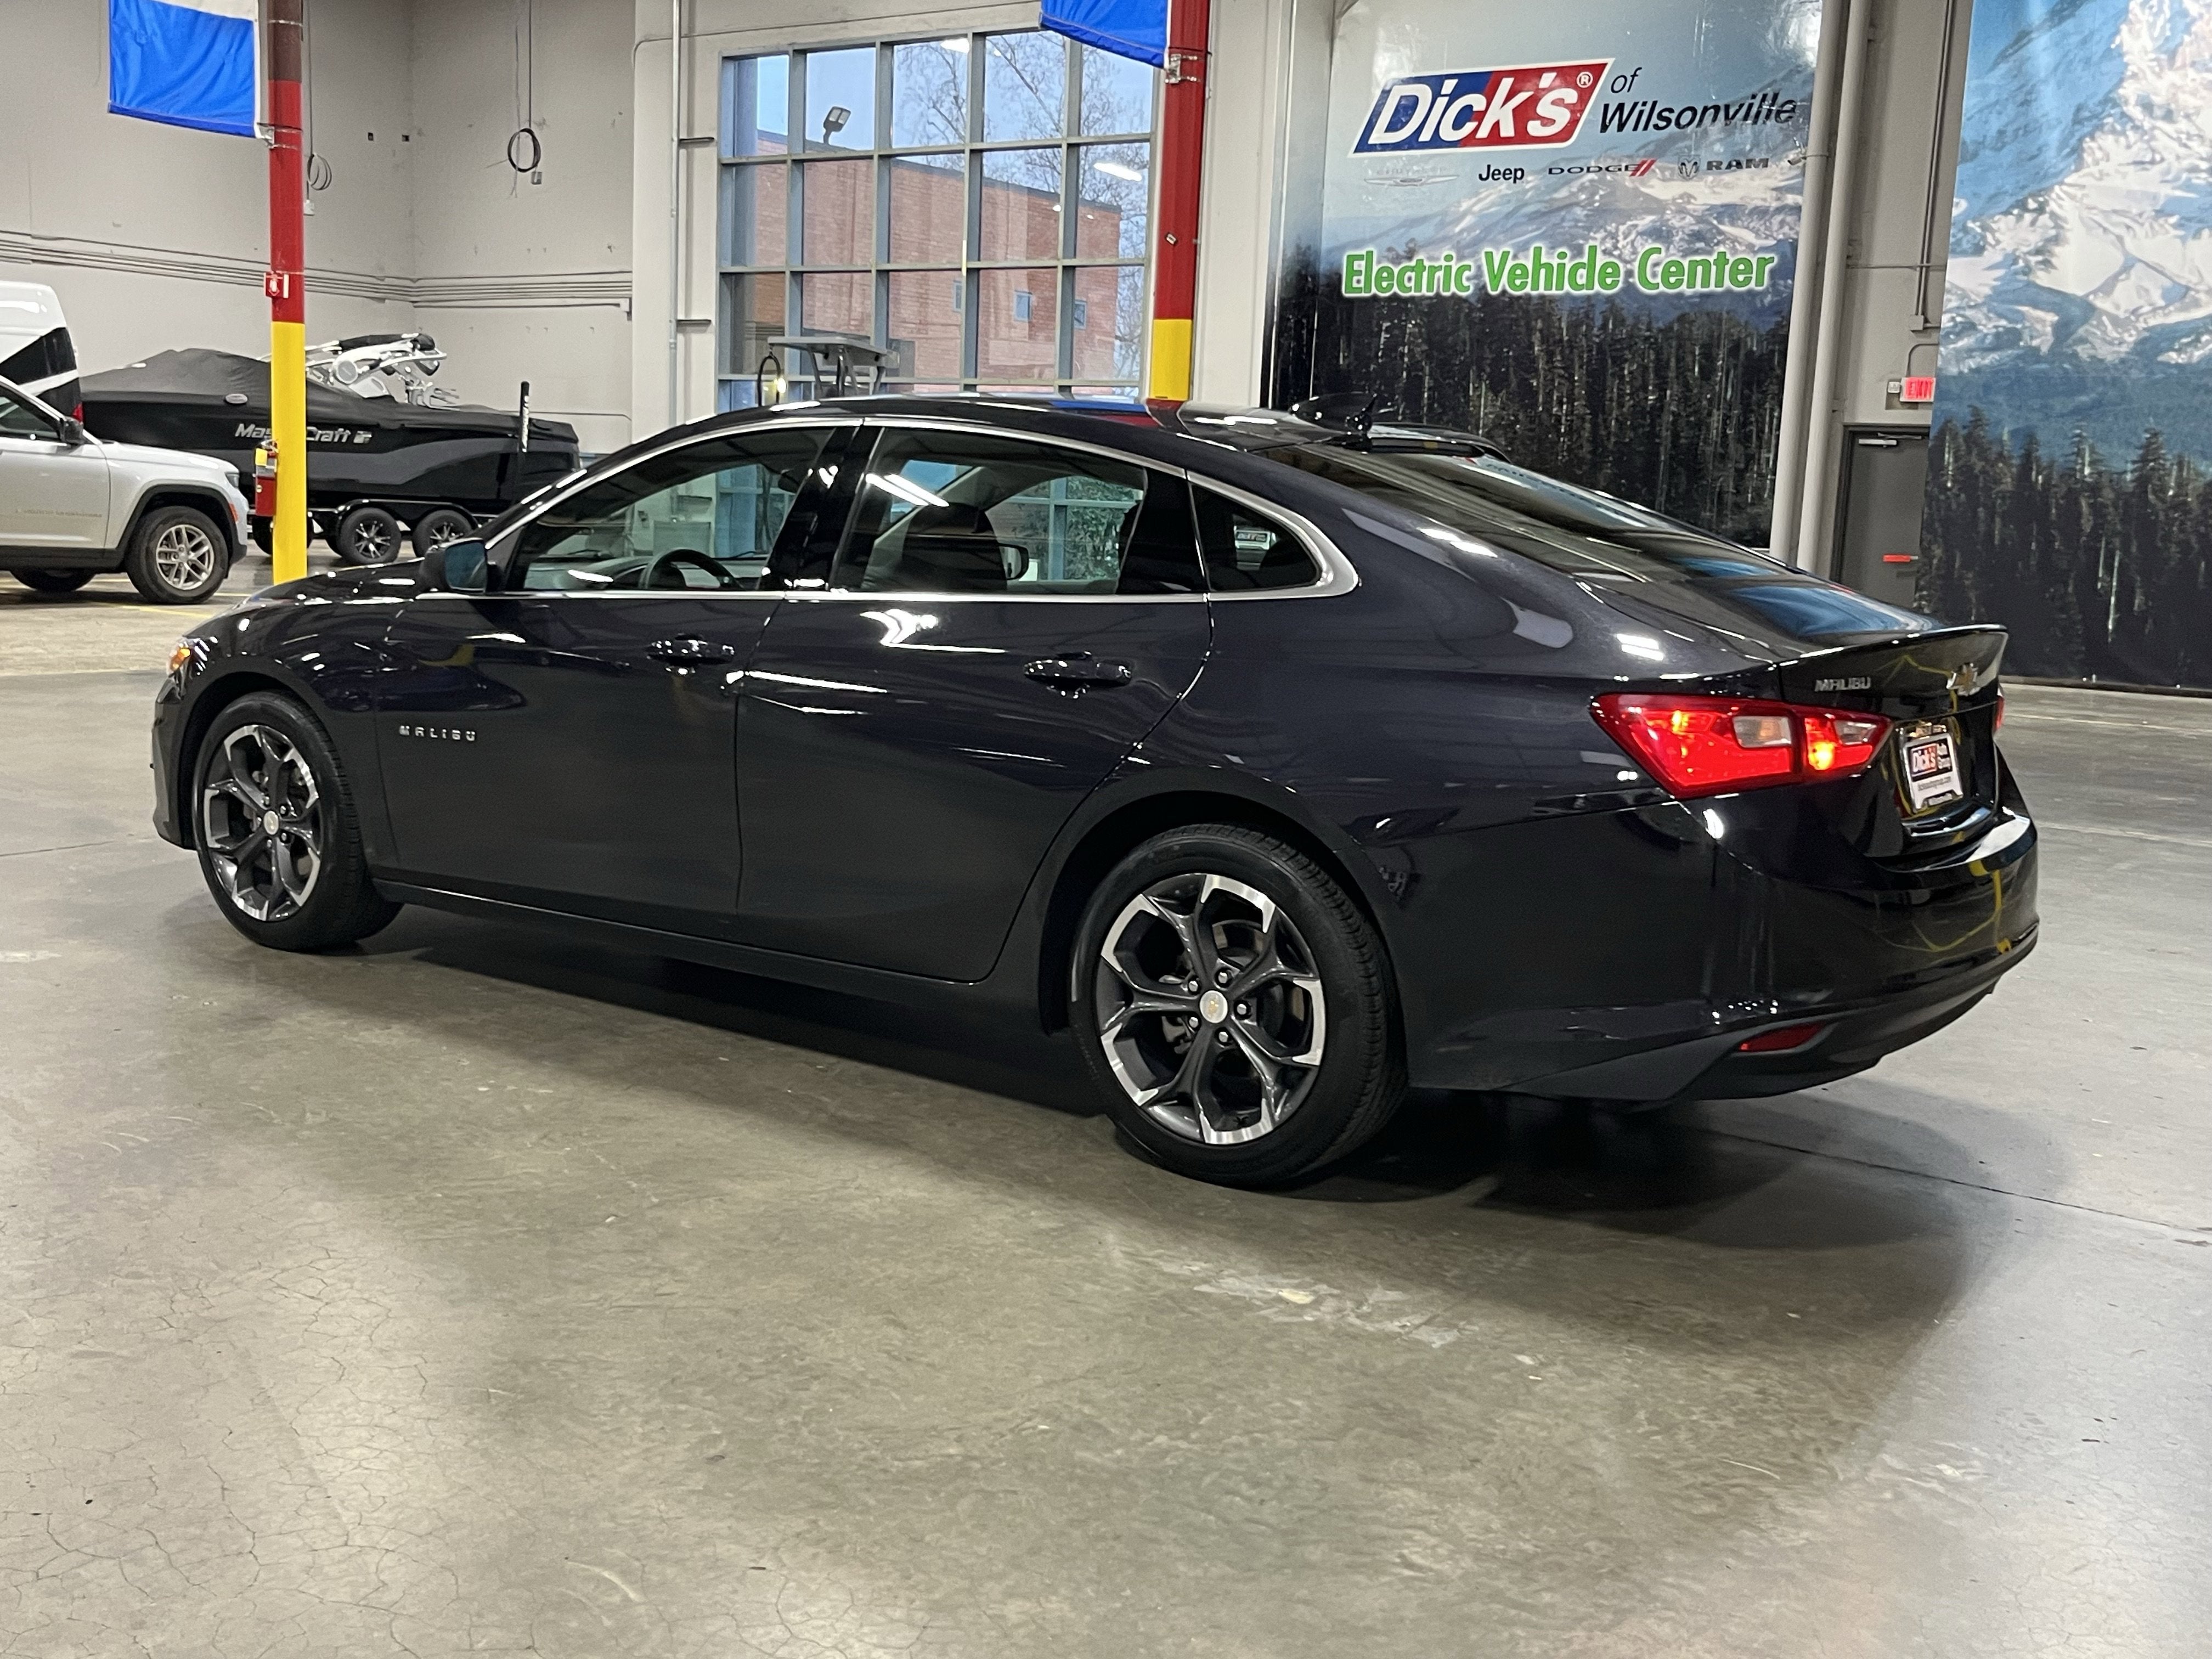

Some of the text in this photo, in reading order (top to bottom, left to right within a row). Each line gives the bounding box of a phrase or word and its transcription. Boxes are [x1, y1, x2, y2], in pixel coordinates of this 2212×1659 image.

[1610, 67, 1642, 93] of
[1600, 90, 1796, 133] Wilsonville
[1479, 158, 1769, 183] Jeep DODGE RAM
[1345, 246, 1775, 294] Electric Vehicle Center
[1907, 379, 1933, 398] EXIT
[1814, 676, 1871, 692] MALIBU
[399, 725, 476, 741] MALIBU
